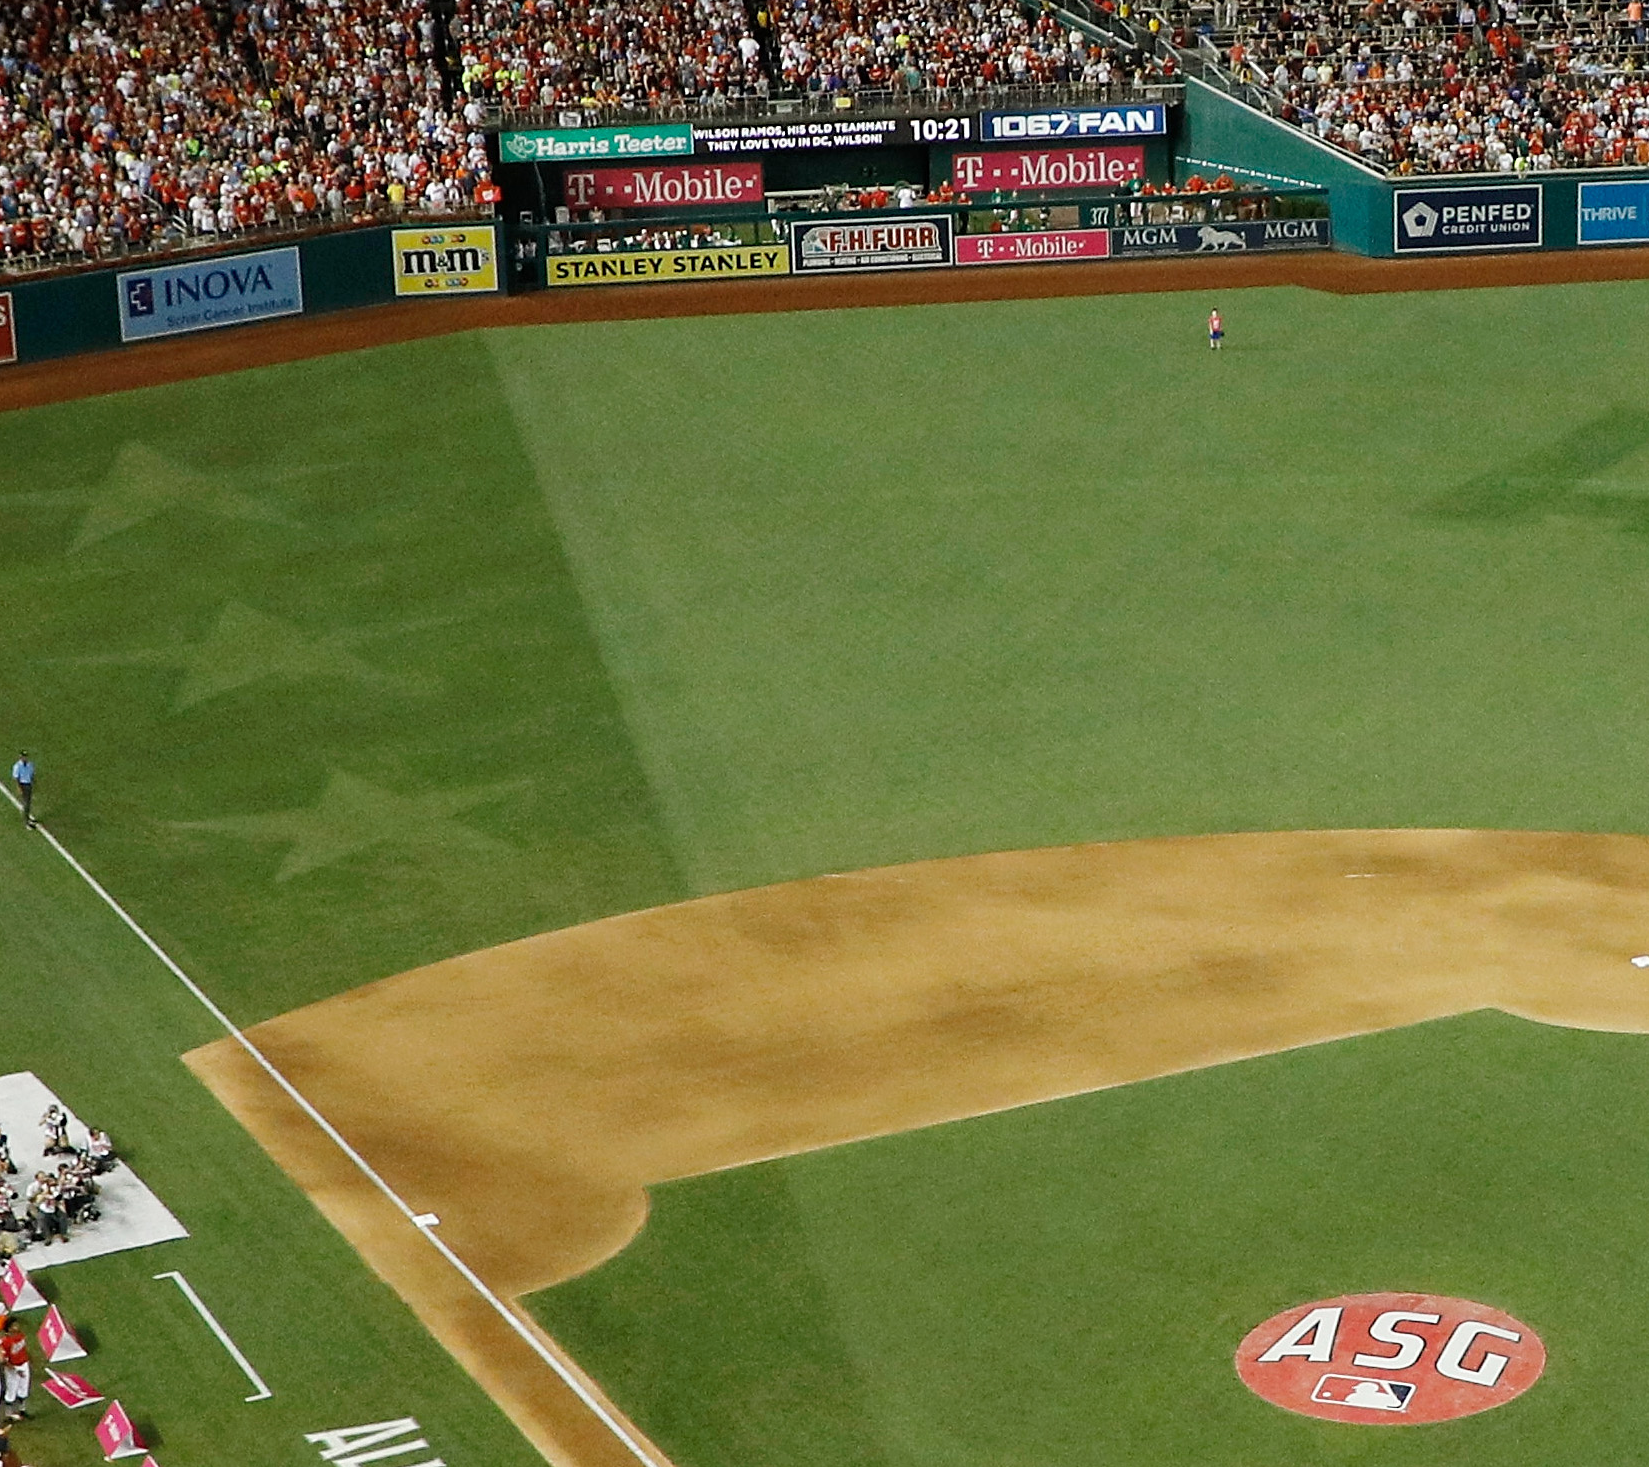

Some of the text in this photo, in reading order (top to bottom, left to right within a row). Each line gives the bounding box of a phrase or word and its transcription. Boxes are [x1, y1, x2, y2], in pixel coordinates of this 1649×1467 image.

[693, 119, 897, 141] WILSON RAMOS, OLD TEAMMATE
[909, 117, 971, 142] 10:21
[1078, 109, 1156, 134] FAN
[535, 132, 688, 159] Harris Teeter
[707, 132, 884, 153] THEY LOVE YOU WILSON!
[1088, 206, 1110, 228] 377
[1441, 202, 1533, 224] PENFED
[1581, 205, 1638, 222] THRIVE
[1122, 227, 1179, 246] MGM
[1441, 220, 1530, 235] CREDIT UNION
[555, 255, 667, 279] STANLEY
[672, 250, 780, 274] STANLEY
[164, 262, 274, 307] INOVA
[1256, 1306, 1521, 1387] ASG
